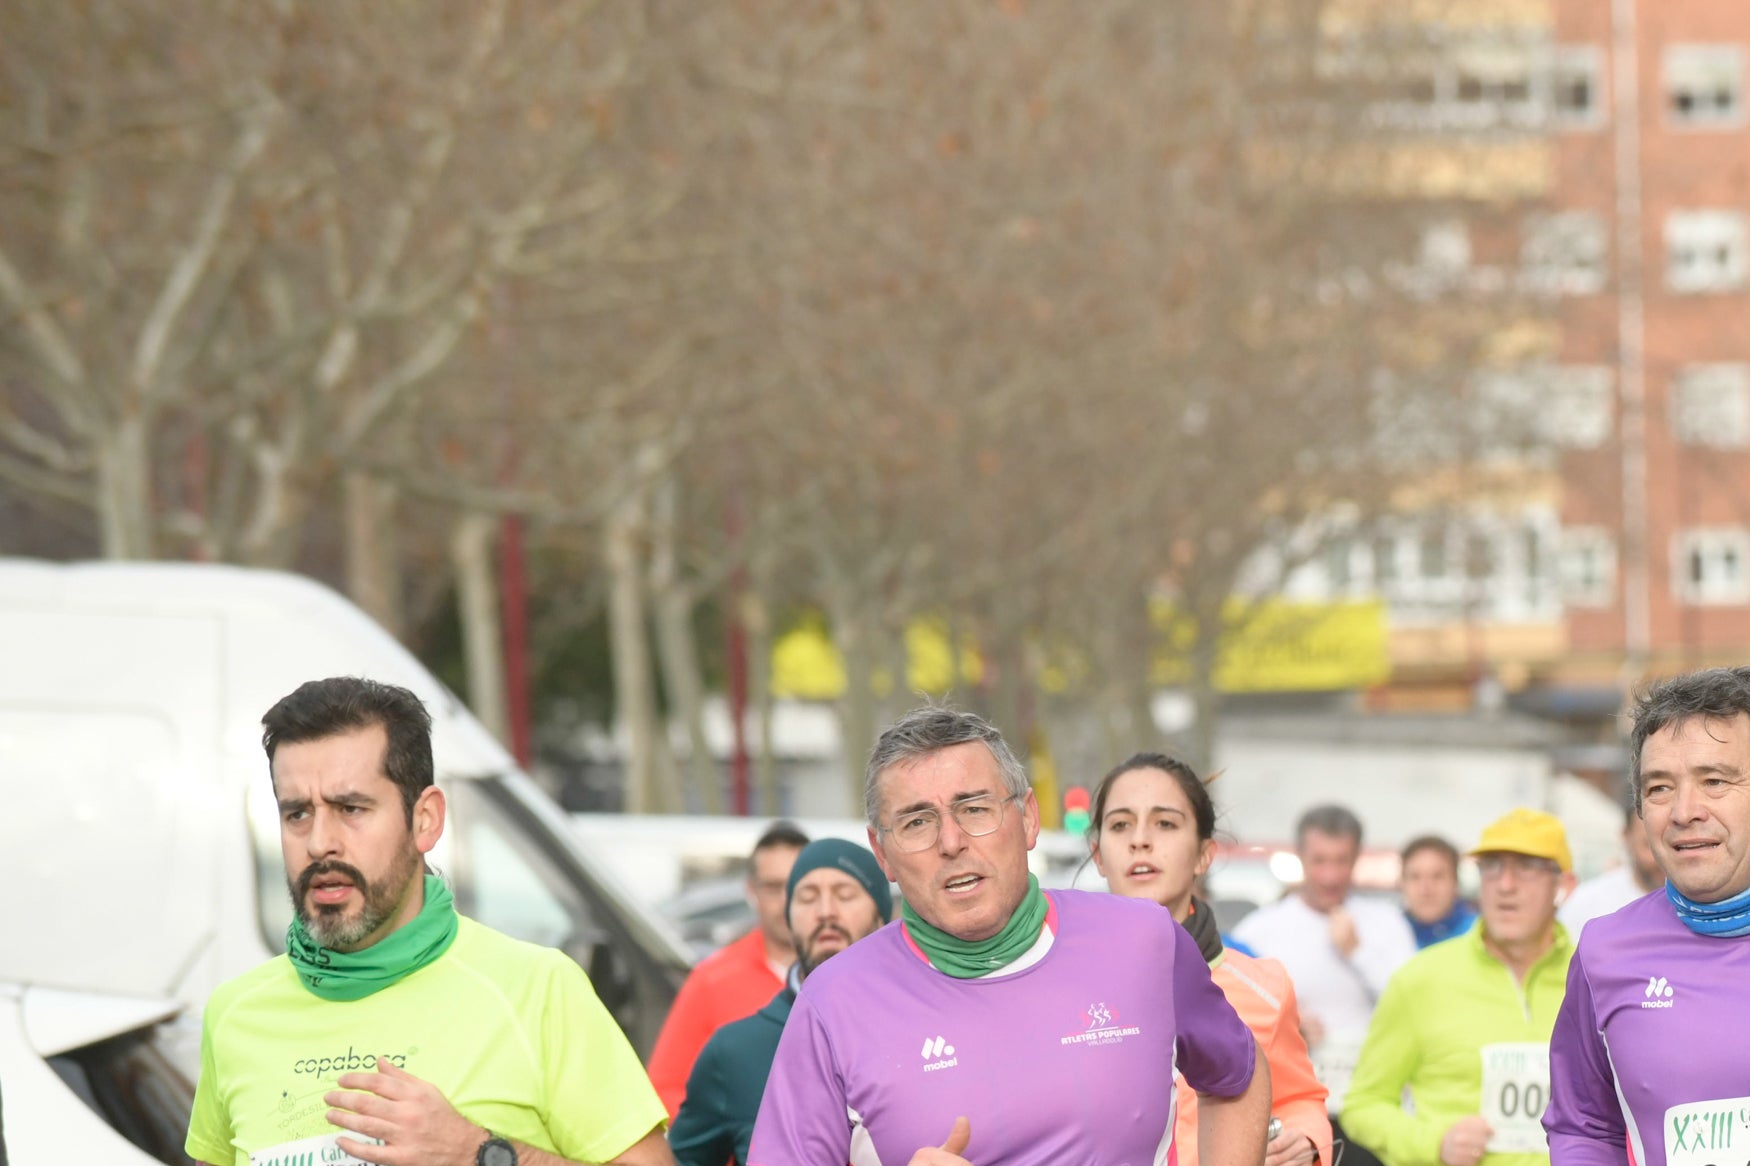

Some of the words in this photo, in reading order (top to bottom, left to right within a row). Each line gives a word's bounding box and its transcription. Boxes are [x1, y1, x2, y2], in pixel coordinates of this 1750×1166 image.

[1642, 1000, 1673, 1009] mobel
[1061, 1031, 1097, 1046] ATLETAS
[1098, 1027, 1140, 1040] POPULARES
[923, 1057, 957, 1072] mobel
[1673, 1110, 1733, 1156] XXIII
